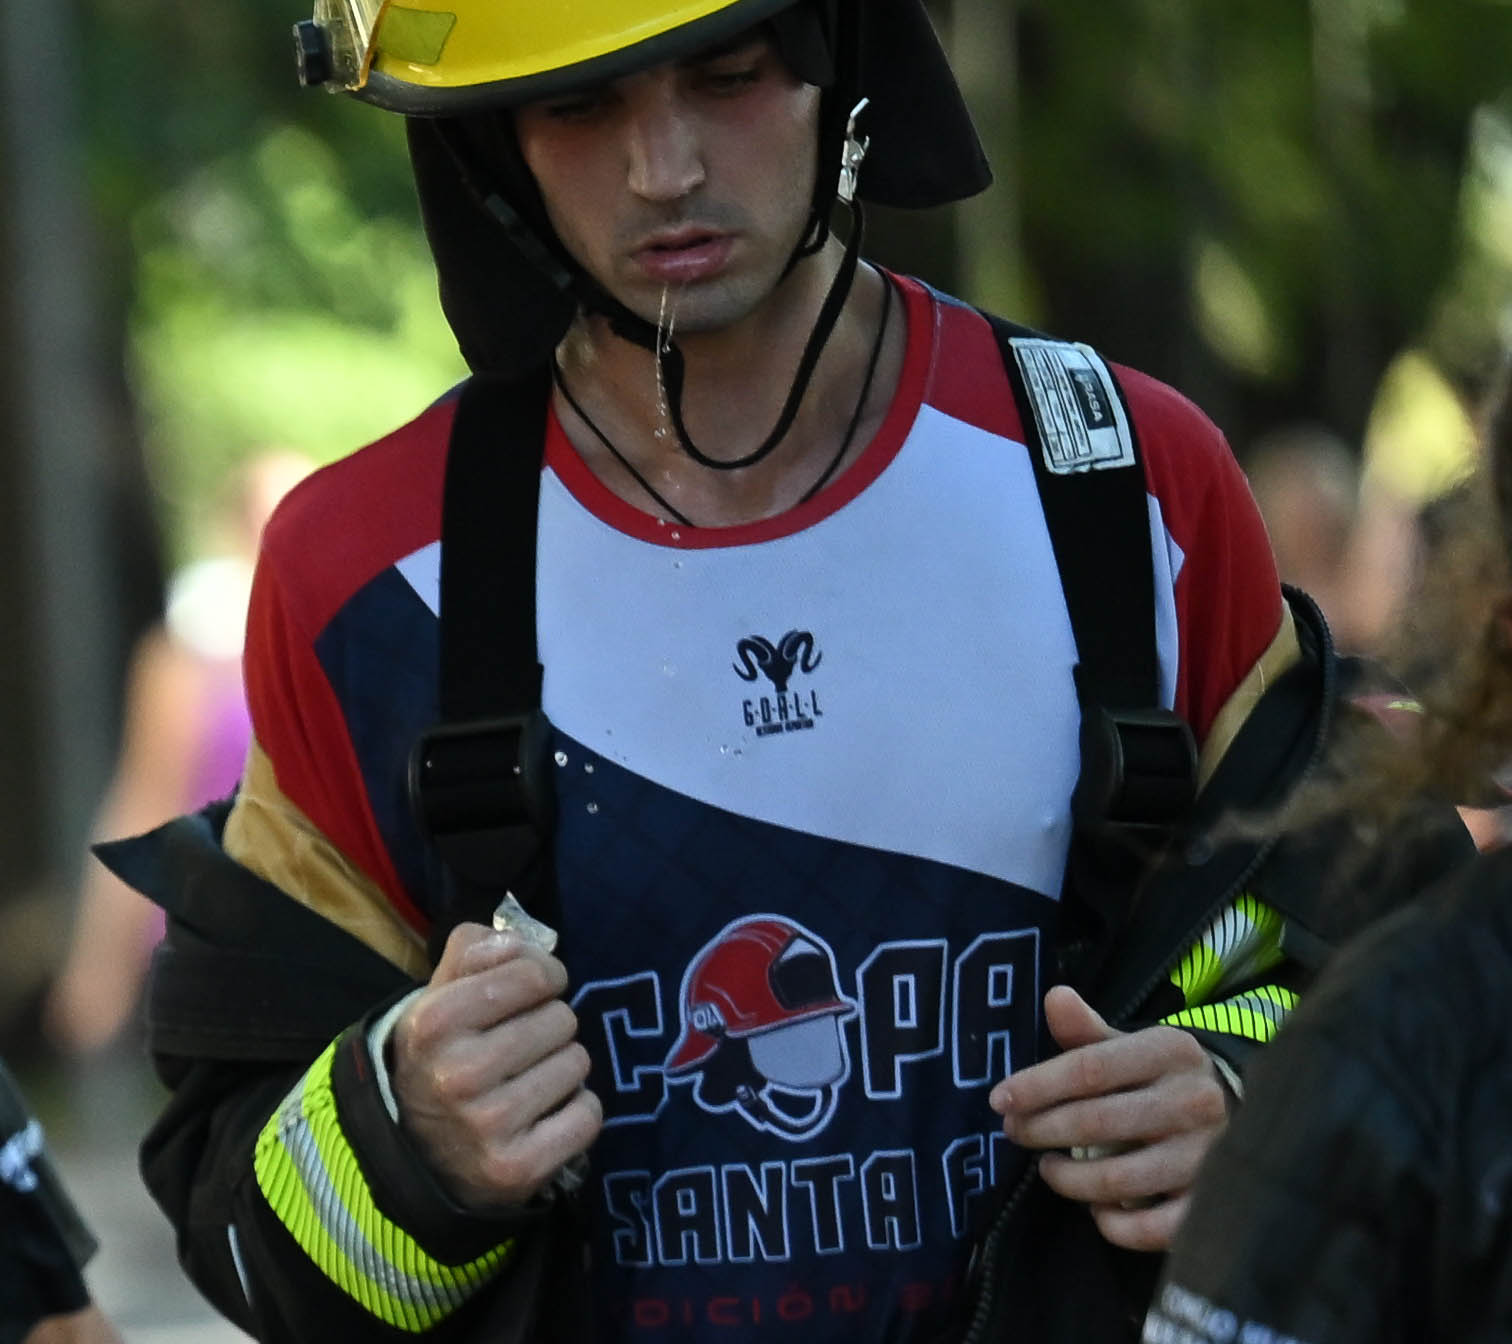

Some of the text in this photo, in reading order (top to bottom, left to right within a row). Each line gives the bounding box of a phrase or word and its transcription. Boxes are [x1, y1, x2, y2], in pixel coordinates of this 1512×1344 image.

[570, 926, 1041, 1128] CPA
[603, 1131, 1004, 1269] SANTA F
[632, 1280, 869, 1328] DICIÓN
